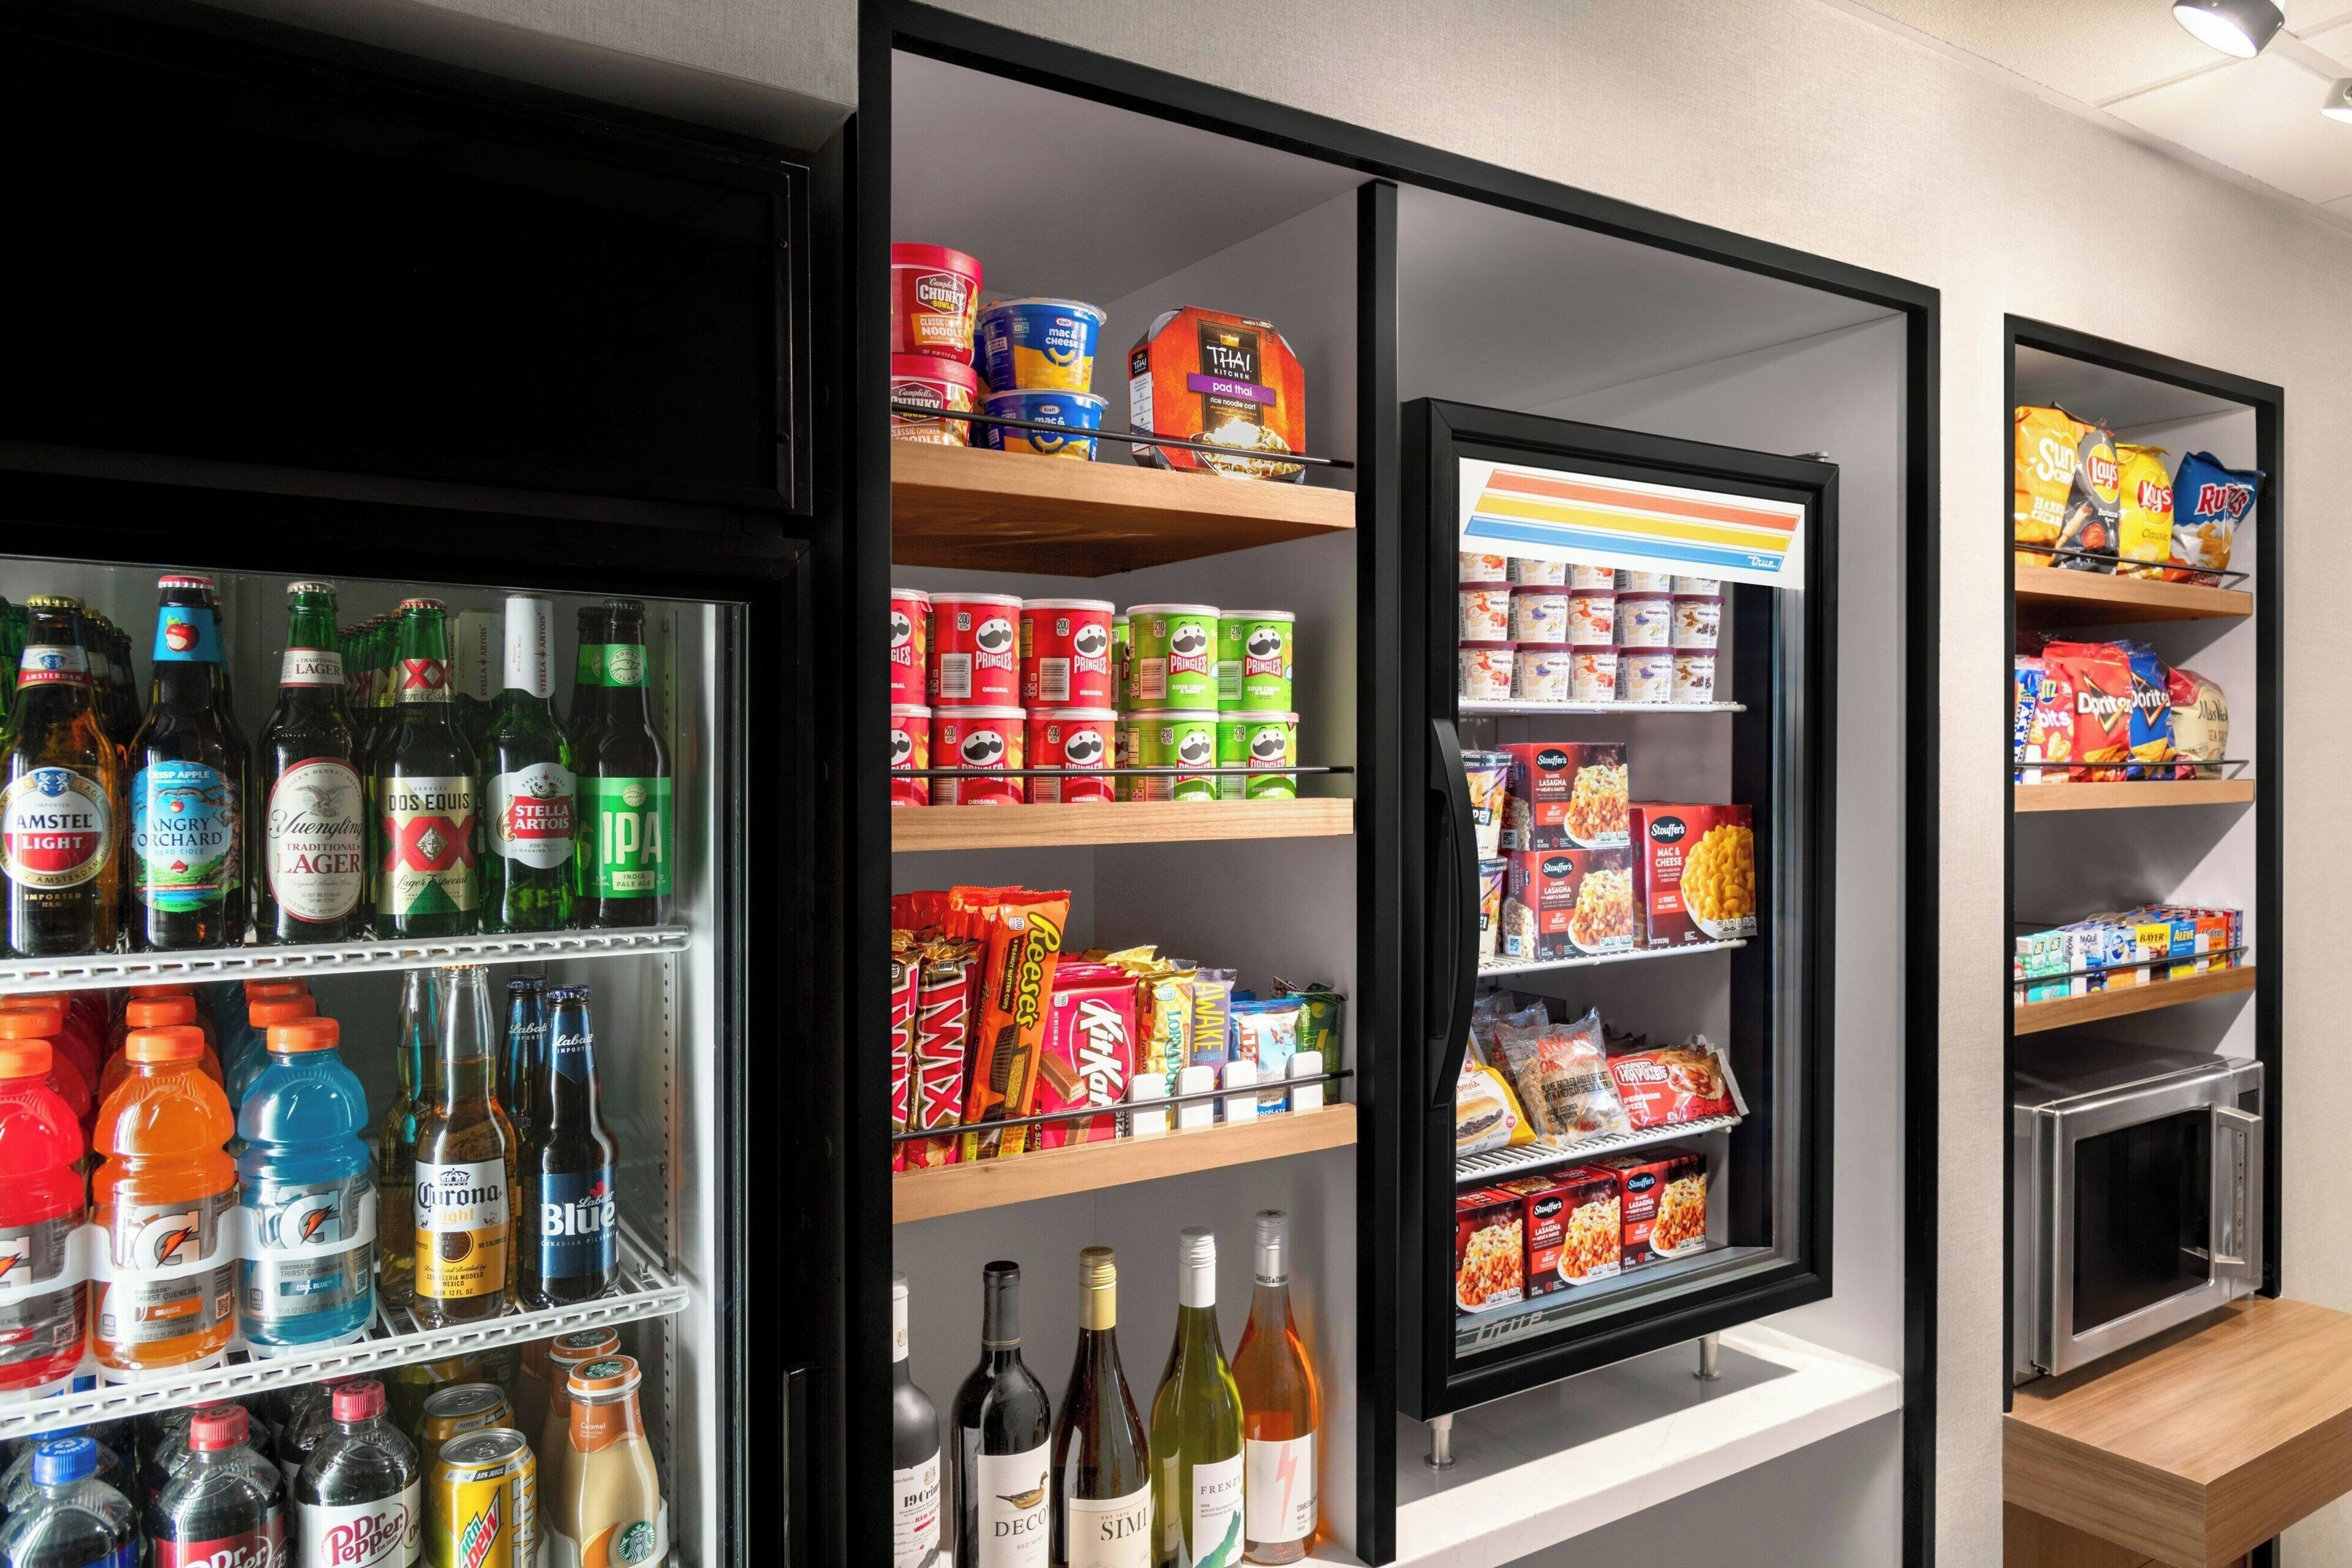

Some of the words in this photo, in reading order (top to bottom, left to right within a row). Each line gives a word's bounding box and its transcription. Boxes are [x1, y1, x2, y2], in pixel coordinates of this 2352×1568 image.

[920, 285, 965, 305] CHUNKY
[933, 300, 955, 311] BOWLS
[920, 317, 944, 327] CLASSIC
[921, 327, 963, 338] NOODLE
[1206, 345, 1251, 372] THAI
[1214, 368, 1250, 380] KITCHEN
[899, 388, 931, 398] Campbell's
[1212, 382, 1232, 393] pad
[1234, 384, 1253, 396] thai
[1223, 399, 1243, 408] noodle
[2091, 457, 2118, 490] Lay's
[2142, 528, 2169, 542] Classic
[959, 613, 970, 624] 200
[1057, 619, 1069, 630] 200
[1154, 621, 1164, 631] 210
[1232, 625, 1242, 635] 210
[975, 650, 1012, 671] PRINGLES
[1074, 656, 1107, 675] PRINGLES
[1170, 654, 1207, 674] PRINGLES
[1246, 657, 1281, 676] PRINGLES
[296, 663, 341, 675] LAGER
[25, 672, 82, 682] AMSTERDAM
[2077, 692, 2132, 717] Doritos
[2035, 707, 2072, 729] bits
[945, 726, 957, 737] 200
[1048, 726, 1060, 737] 200
[1161, 729, 1172, 739] 210
[1235, 726, 1245, 736] 210
[1537, 755, 1567, 766] Stouffer's
[389, 794, 420, 812] DOS
[425, 793, 469, 812] EQUIS
[515, 805, 569, 817] STELLA
[17, 813, 90, 829] AMSTEL
[151, 818, 210, 832] ANGRY
[268, 809, 363, 840] Yuengling
[514, 818, 569, 830] ARTOIS
[1651, 823, 1685, 838] Stouffer's
[21, 836, 83, 850] LIGHT
[137, 832, 221, 846] ORCHARD
[602, 810, 663, 865] IPA
[285, 843, 356, 851] TRADITIONAL
[1657, 848, 1673, 857] MAC
[1675, 846, 1680, 856] &
[276, 853, 361, 875] LAGER
[1543, 862, 1573, 873] Stouffer's
[1655, 856, 1683, 867] CHEESE
[36, 859, 101, 884] AMSTERDAM
[392, 874, 426, 894] Lager
[427, 873, 469, 889] Especial
[2079, 933, 2097, 946] NyQuil
[2139, 932, 2165, 943] BAYER
[2173, 929, 2195, 942] ALEVE
[1010, 944, 1019, 970] PEANUT
[1016, 911, 1061, 1029] Reese's
[1194, 981, 1226, 1052] AWAKE
[552, 1033, 594, 1047] Labatt
[918, 960, 975, 1129] TWIX
[557, 1045, 592, 1054] IMPORTED
[1194, 1051, 1224, 1062] CAFFEINATED
[1627, 1177, 1655, 1189] Stouffer's
[417, 1182, 499, 1213] Corona
[577, 1190, 614, 1208] Labatt
[1629, 1198, 1654, 1209] LASAGNA
[1534, 1200, 1562, 1215] Stouffer's
[541, 1201, 615, 1236] Blue
[1535, 1223, 1561, 1235] LASAGNA
[307, 1261, 343, 1276] QUENCHER
[460, 1271, 484, 1280] MODELO
[313, 1280, 328, 1289] BLUE
[135, 1293, 160, 1302] THIRST
[163, 1286, 203, 1300] QUENCHER
[251, 1290, 262, 1301] 140
[155, 1305, 182, 1316] ORANGE
[103, 1315, 115, 1327] 140
[458, 1419, 482, 1429] CAFFEINE
[489, 1467, 504, 1477] JUICE
[1200, 1474, 1242, 1495] FRENZY
[903, 1494, 918, 1508] 19
[353, 1512, 386, 1542] Dr
[1101, 1506, 1147, 1541] SIMI
[325, 1513, 404, 1567] Pepper
[1017, 1542, 1030, 1550] RED
